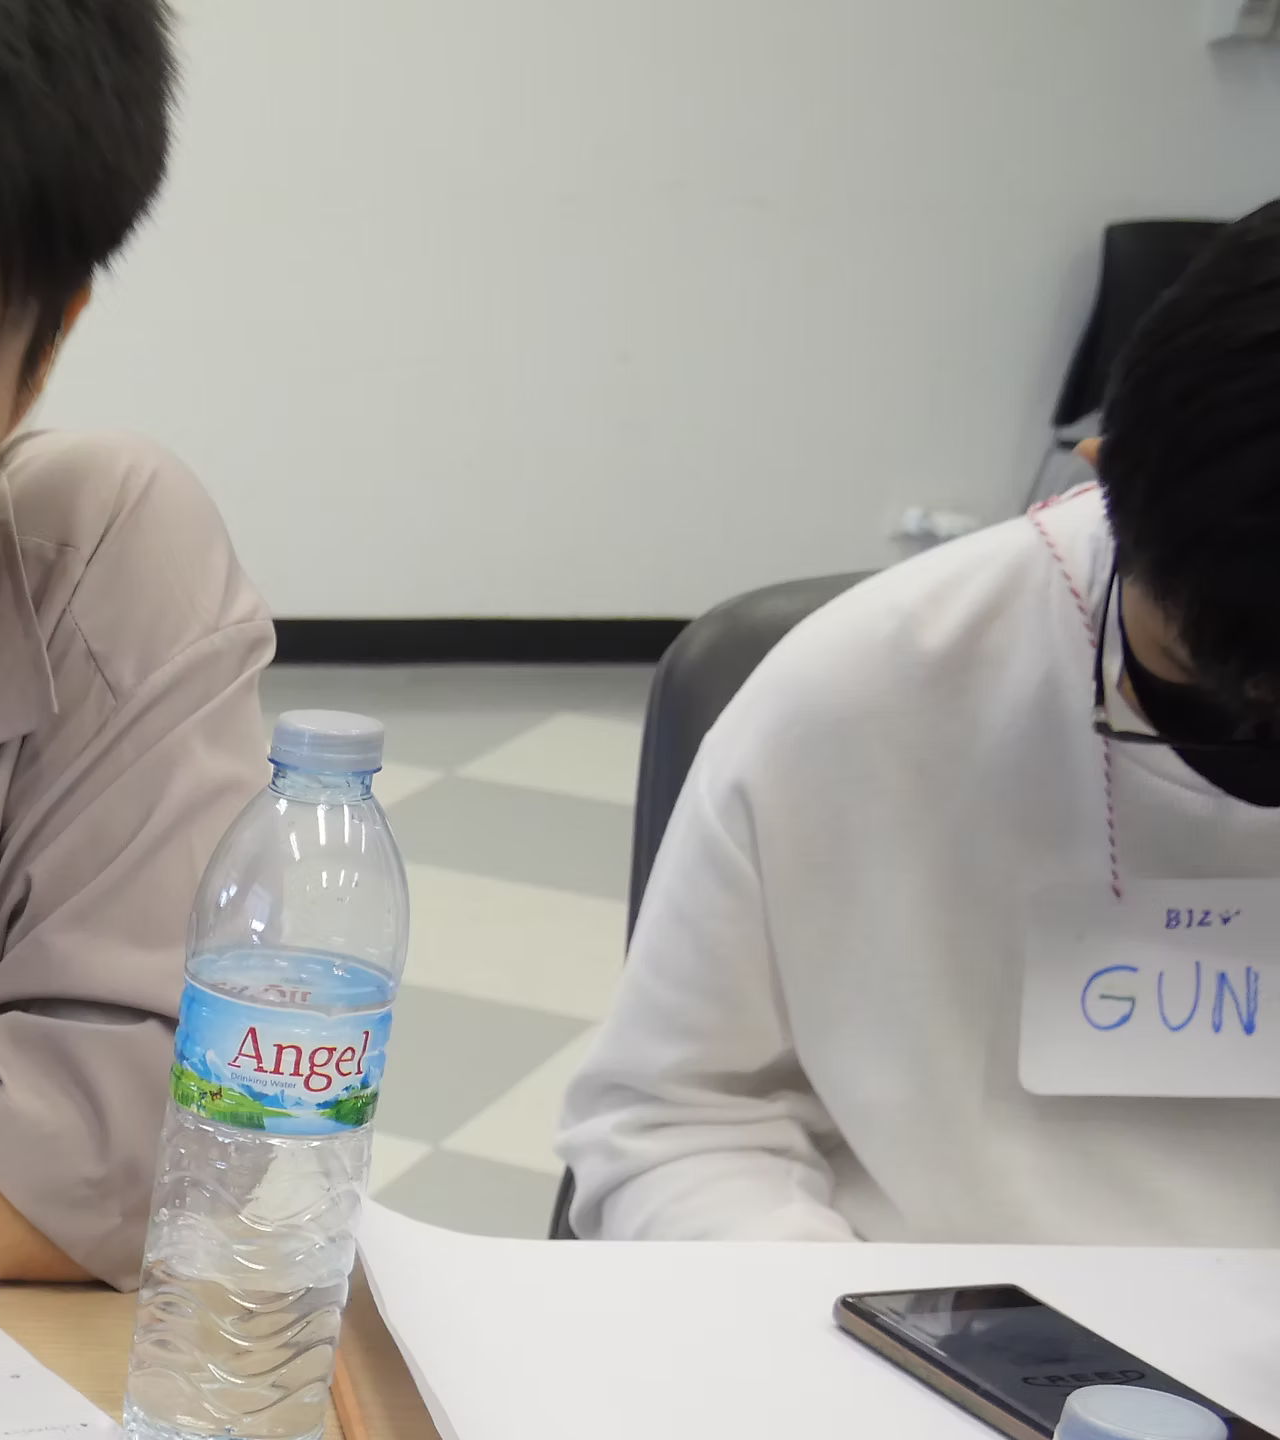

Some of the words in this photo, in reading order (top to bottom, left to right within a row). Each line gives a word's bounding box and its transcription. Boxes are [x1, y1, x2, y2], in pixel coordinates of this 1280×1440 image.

[1081, 960, 1259, 1036] GUN
[227, 1026, 369, 1093] Angel
[230, 1072, 267, 1088] Drinking
[269, 1079, 297, 1090] Water
